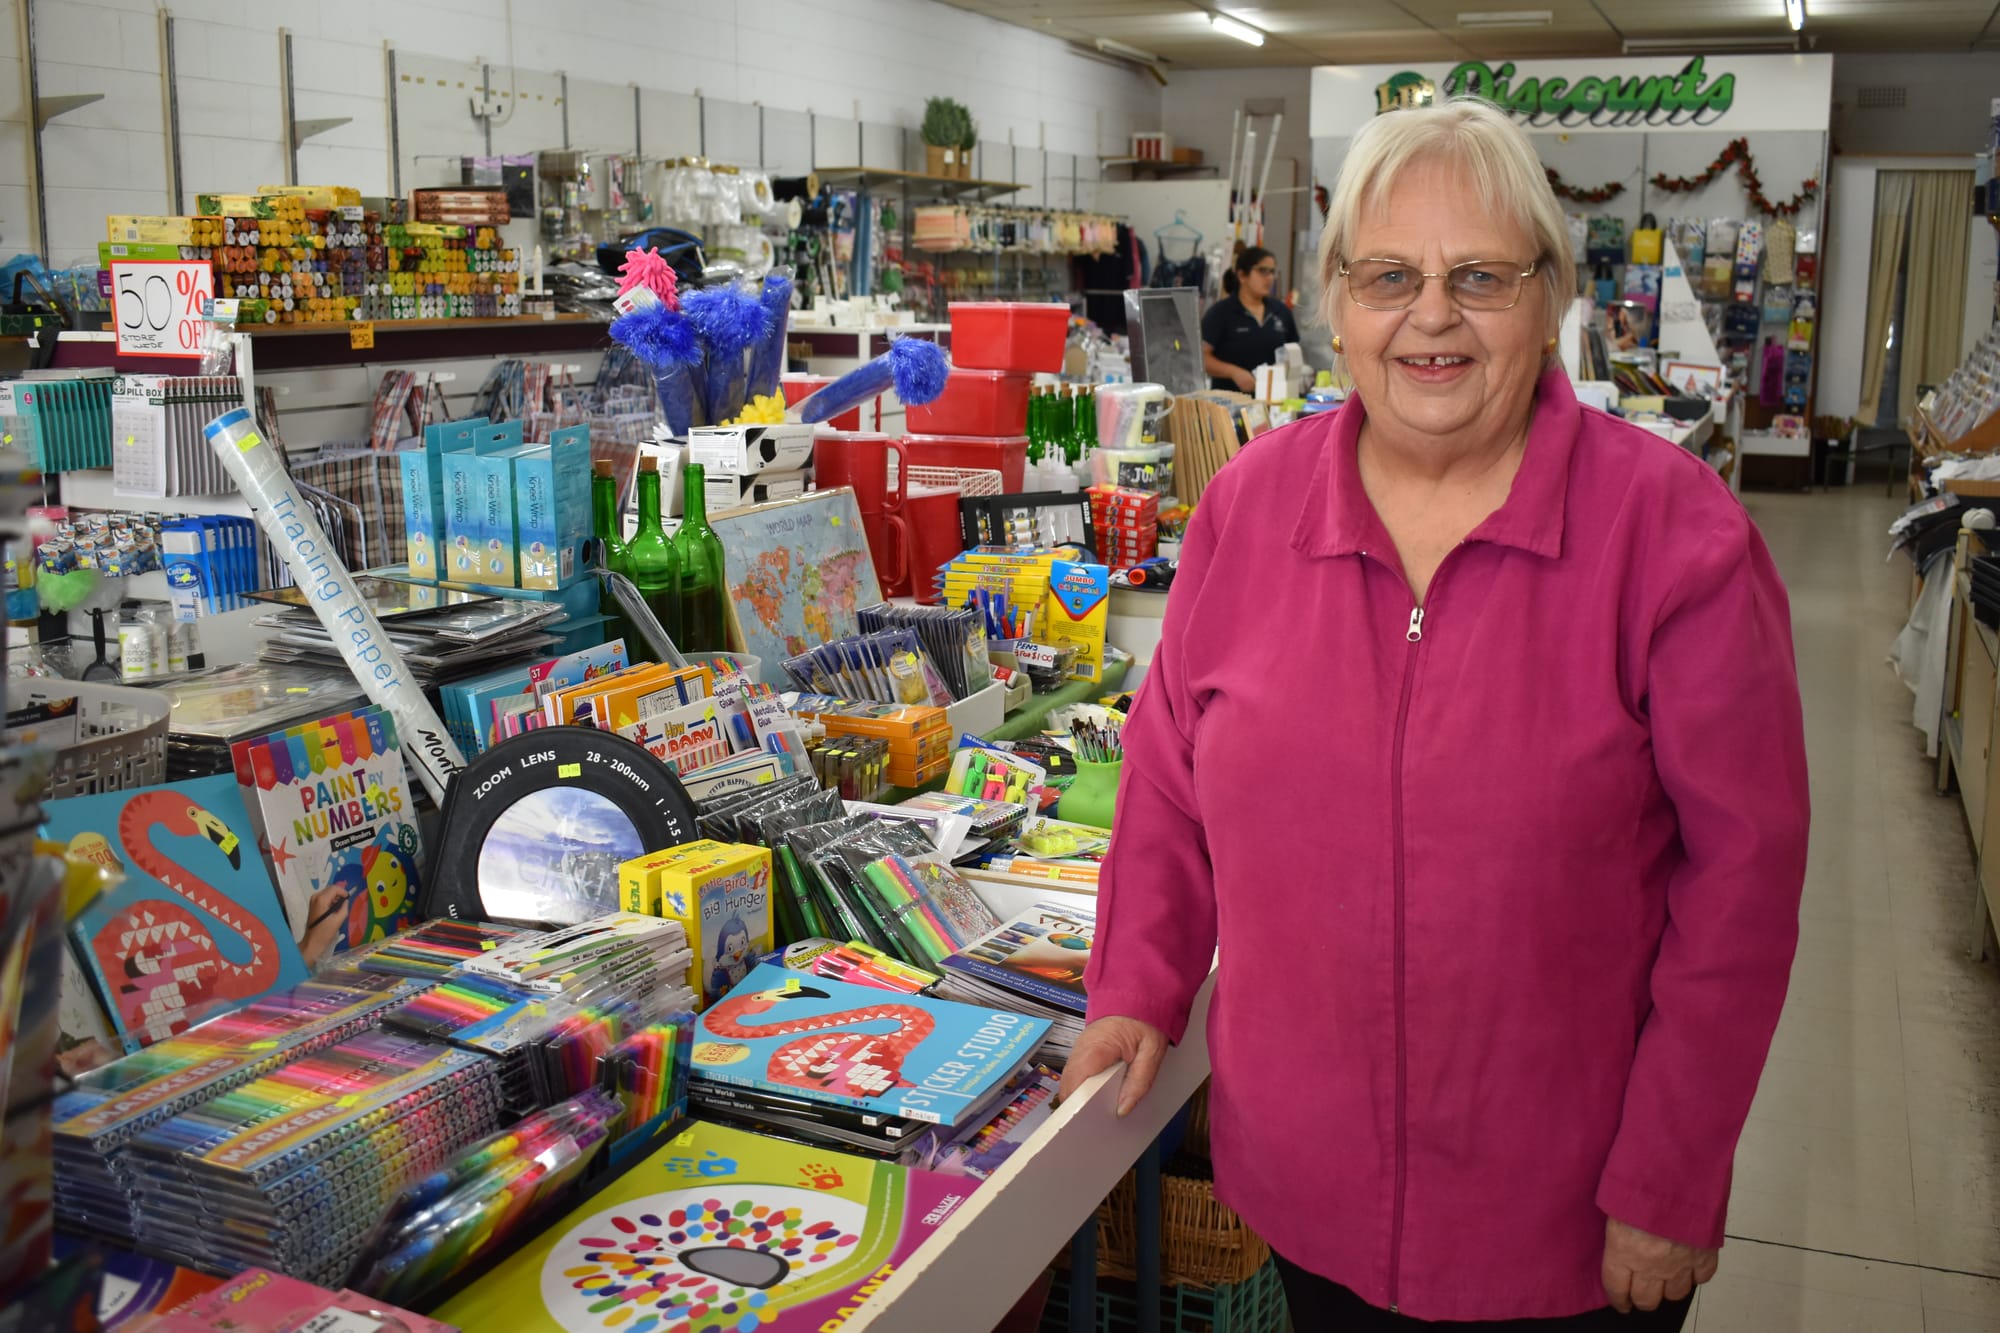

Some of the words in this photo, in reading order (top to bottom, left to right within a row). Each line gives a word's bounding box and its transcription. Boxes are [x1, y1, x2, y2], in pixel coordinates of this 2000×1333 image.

[1446, 55, 1736, 117] Discounts
[119, 272, 173, 331] 50
[176, 270, 209, 315] %
[120, 334, 157, 342] STORE
[126, 388, 144, 397] PILL
[146, 389, 163, 398] BOX
[410, 469, 419, 492] Knee
[454, 471, 463, 495] Knee
[487, 474, 496, 499] Knee
[528, 476, 538, 502] Knee
[411, 493, 421, 520] Wrap
[455, 497, 465, 523] Wrap
[488, 500, 497, 526] Wrap
[529, 502, 539, 528] Wrap
[766, 518, 795, 535] WORLD
[798, 514, 813, 529] MAP
[167, 567, 191, 576] Cotton
[1063, 575, 1096, 585] JUMBO
[271, 491, 344, 601] Tracing
[338, 605, 402, 691] Paper
[1016, 640, 1038, 651] PENS
[531, 668, 541, 679] 37
[719, 697, 736, 709] Glue
[753, 705, 778, 717] Metallic
[664, 720, 685, 739] How
[758, 718, 772, 728] Glue
[300, 768, 366, 813] PAINT
[368, 771, 384, 786] BY
[473, 766, 512, 799] ZOOM
[520, 750, 557, 768] LENS
[586, 751, 600, 764] 28
[609, 758, 650, 792] 200mm
[667, 817, 682, 837] 3.5
[293, 786, 403, 847] NUMBERS
[334, 837, 350, 848] Ocean
[404, 833, 413, 847] 6
[698, 877, 723, 899] Little
[703, 899, 720, 920] Big
[725, 893, 766, 912] Hunger
[583, 951, 594, 959] Mini
[595, 945, 615, 955] Colored
[616, 940, 634, 948] Pencils
[901, 1060, 977, 1107] STICKER
[957, 1013, 1020, 1060] STUDIO
[705, 1071, 729, 1083] STICKER
[85, 1057, 236, 1124] MARKERS
[714, 1088, 736, 1098] Worlds
[733, 1100, 755, 1110] Worlds
[219, 1102, 348, 1163] MARKERS
